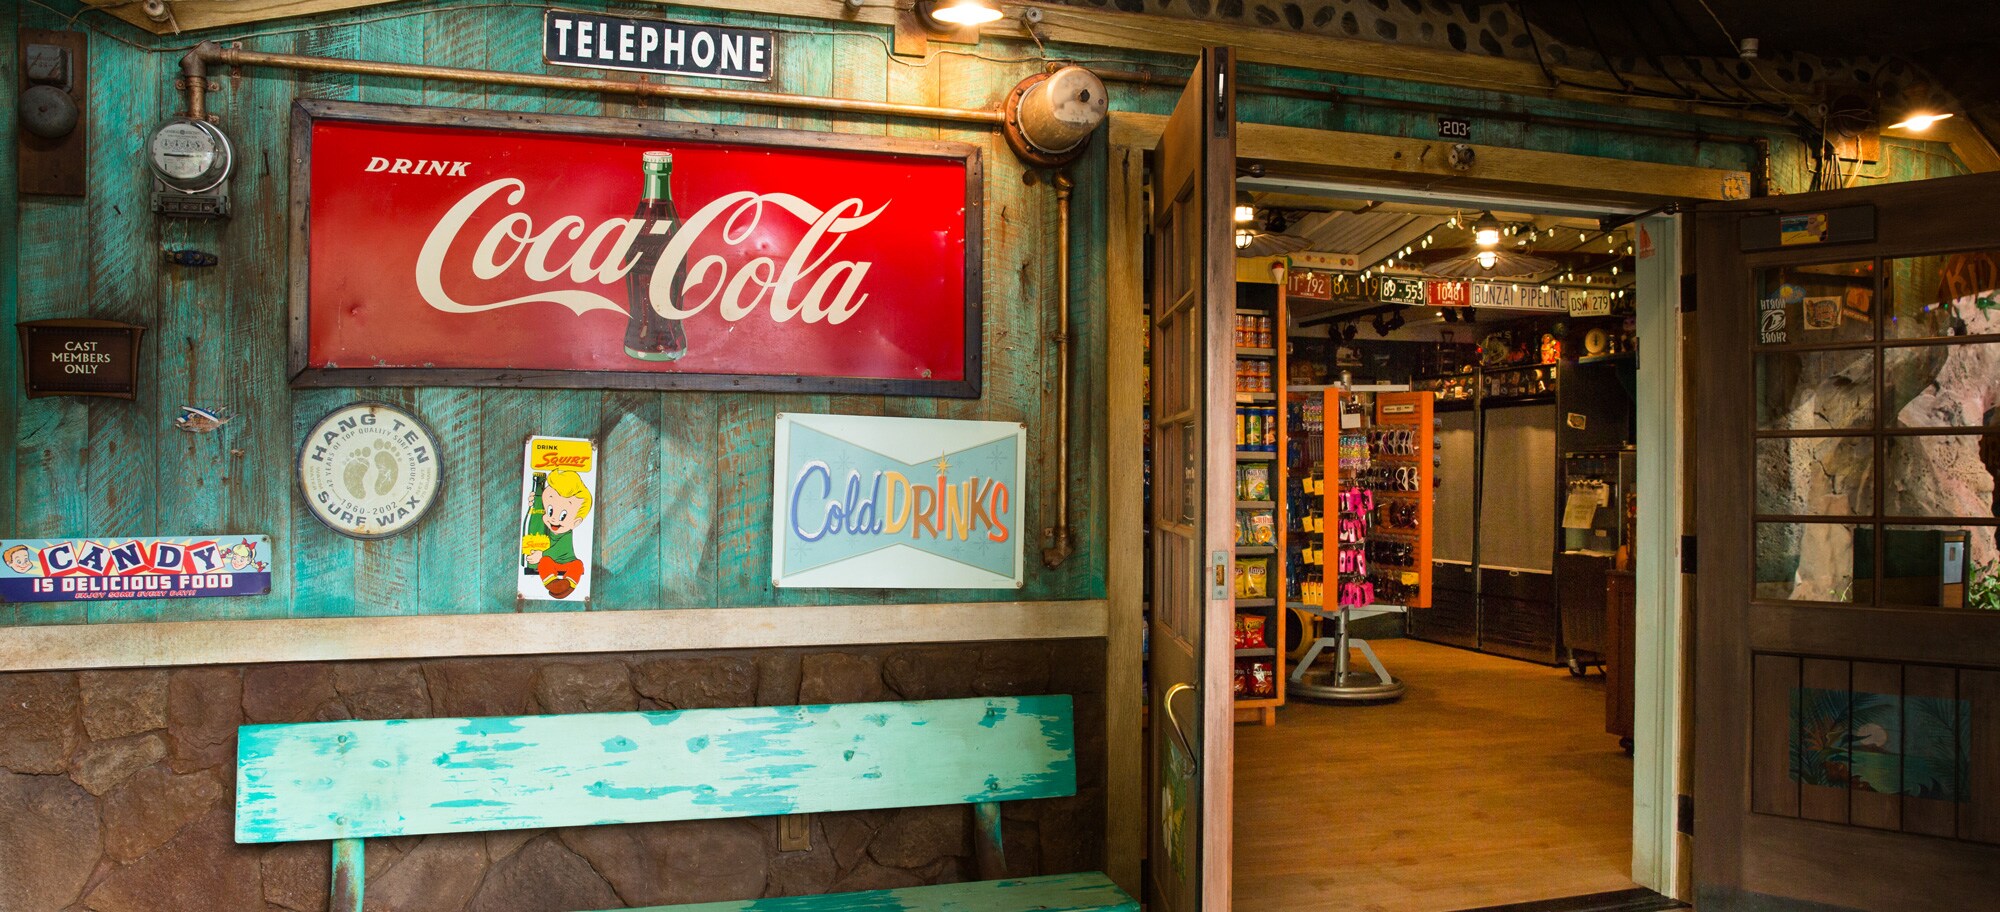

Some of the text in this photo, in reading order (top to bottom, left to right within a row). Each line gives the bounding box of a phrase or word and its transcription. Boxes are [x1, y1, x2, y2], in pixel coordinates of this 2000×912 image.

[554, 18, 765, 73] TELEPHONE
[1443, 120, 1467, 136] 203
[365, 155, 472, 178] DRINK
[415, 177, 893, 326] Coca-Cola
[1520, 288, 1566, 308] PIPELINE
[1592, 296, 1608, 310] 279
[64, 341, 98, 351] CAST
[51, 352, 111, 363] MEMBERS
[64, 364, 98, 374] ONLY
[312, 413, 430, 464] HANG TEN
[342, 430, 356, 442] TOP
[358, 427, 392, 437] QUALITY
[394, 435, 408, 450] SURF
[407, 452, 416, 490] PRODUCTS
[535, 452, 590, 468] SQUIRT
[317, 490, 421, 528] SURF WAX
[340, 498, 398, 515] 1960-2002
[790, 459, 883, 542] Cold
[48, 542, 216, 572] CANDY
[33, 574, 233, 592] IS DELICIOUS FOOD
